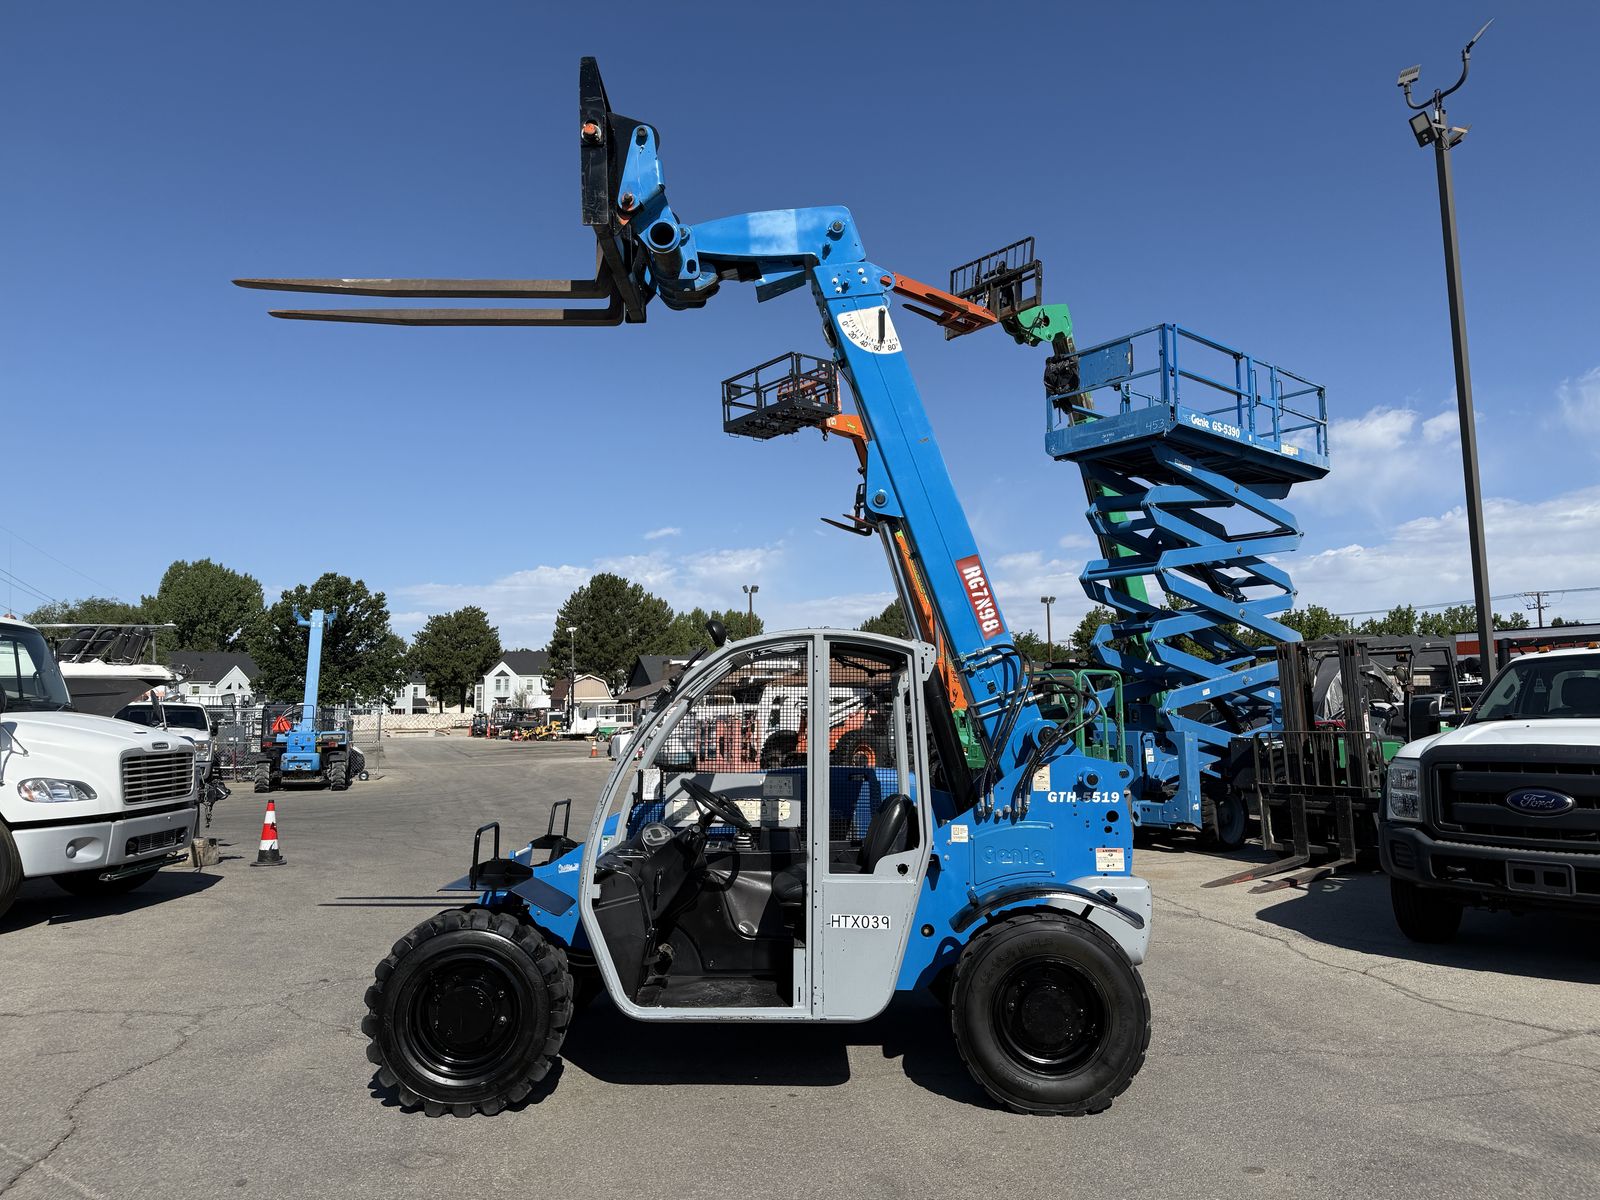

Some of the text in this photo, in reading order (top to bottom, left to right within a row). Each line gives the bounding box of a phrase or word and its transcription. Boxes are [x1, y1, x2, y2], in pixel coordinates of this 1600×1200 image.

[1191, 414, 1240, 439] Genie GS-5390
[1047, 791, 1120, 804] GTH-5519
[1520, 793, 1556, 808] Ford
[831, 915, 890, 929] HTX039
